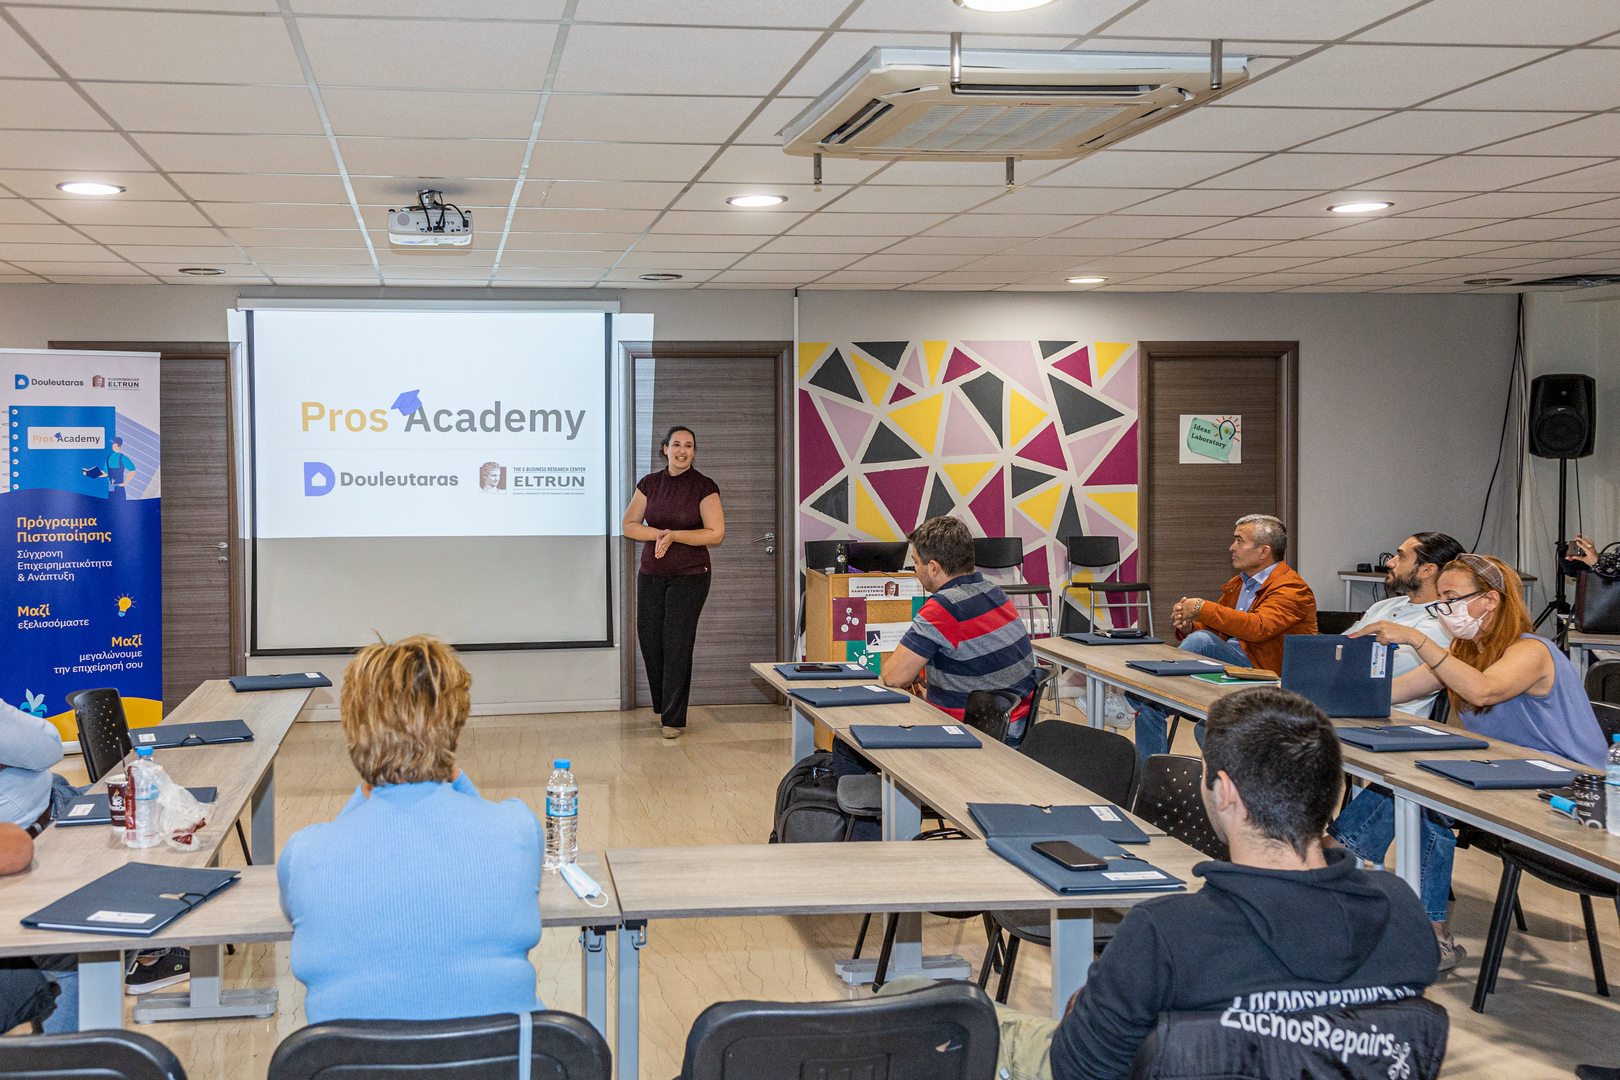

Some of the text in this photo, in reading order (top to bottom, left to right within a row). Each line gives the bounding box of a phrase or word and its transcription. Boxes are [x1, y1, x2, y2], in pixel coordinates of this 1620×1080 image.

[31, 377, 84, 387] Douleutaras
[301, 400, 586, 441] Pros Academy
[1193, 424, 1211, 434] Ideas
[33, 434, 100, 444] Pros Academy
[1191, 432, 1227, 449] Laboratory
[340, 471, 459, 487] Douleutaras
[514, 475, 585, 487] ELTRUN
[17, 515, 98, 530] Πρόγραμμα
[17, 529, 112, 543] Πιστοποίησης
[17, 549, 63, 560] Σύγχρονη
[17, 559, 113, 571] Επιχειρηματικότητα
[17, 572, 75, 583] & Ανάπτυξη
[17, 603, 50, 617] Μαζί
[17, 618, 90, 630] εξελισσόμαστε
[111, 634, 143, 647] Μαζί
[79, 650, 143, 662] μεγαλώνουμε
[53, 661, 143, 675] την επιχείρησή σου
